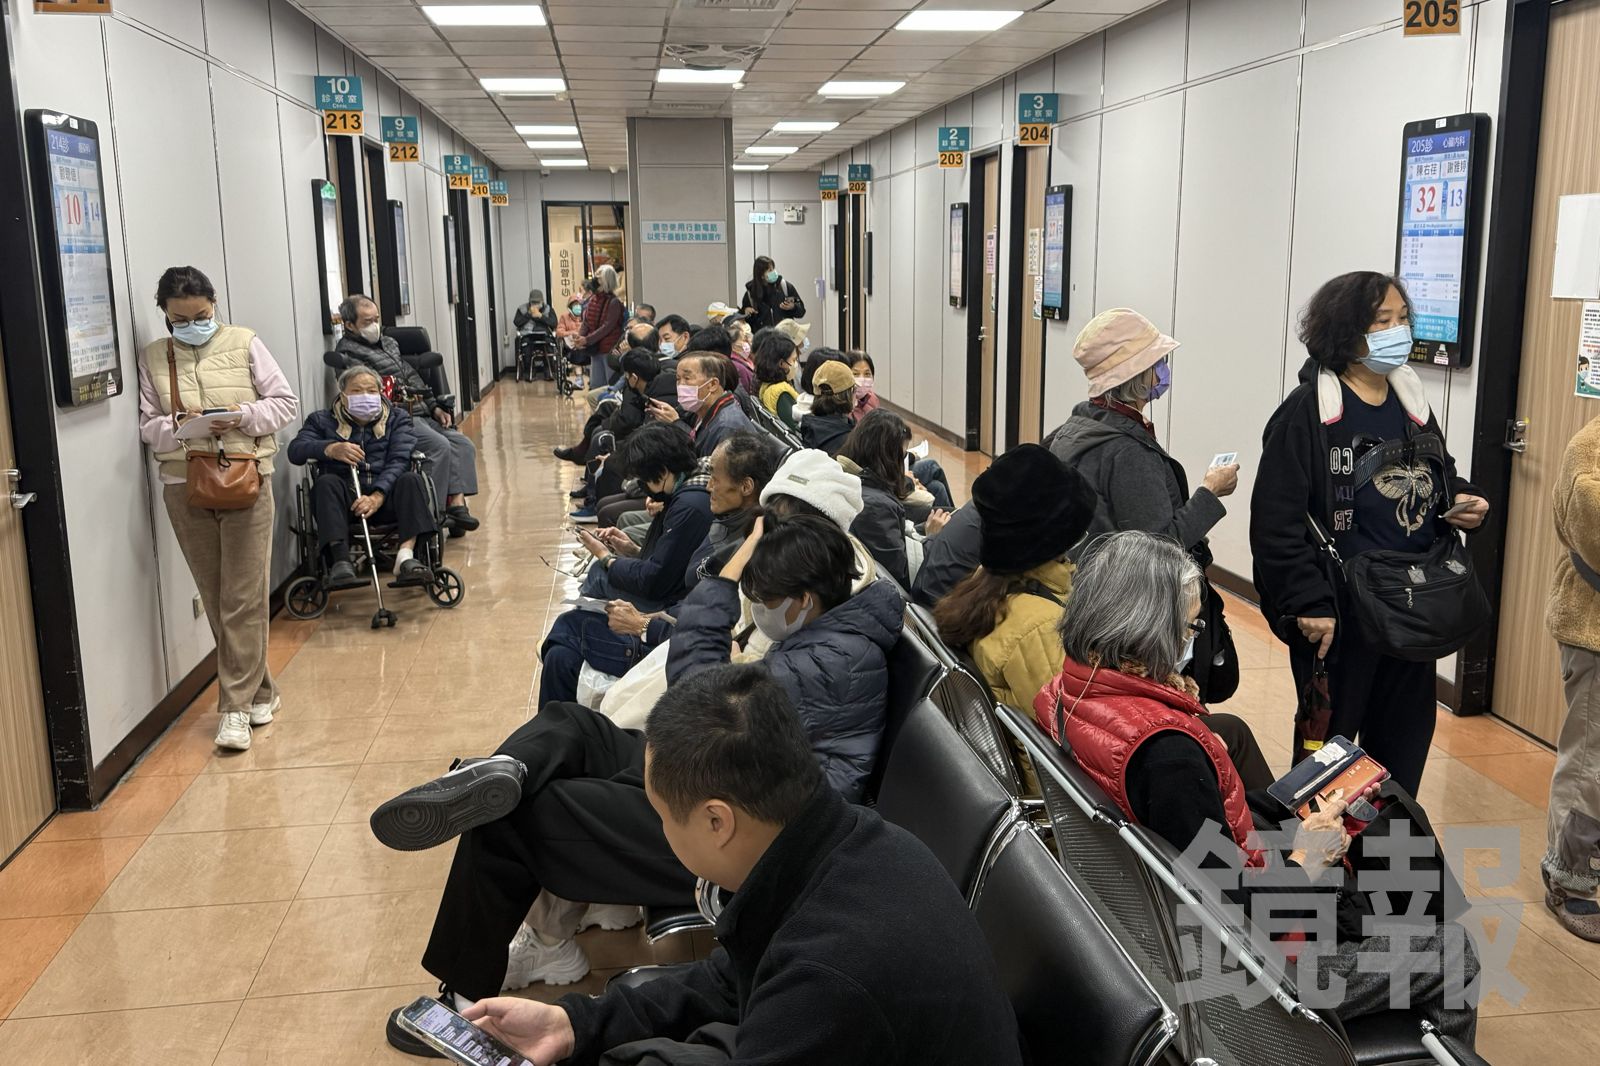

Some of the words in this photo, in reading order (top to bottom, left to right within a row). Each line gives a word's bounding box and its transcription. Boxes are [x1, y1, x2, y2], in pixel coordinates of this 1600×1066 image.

[1406, 0, 1459, 28] 205
[327, 78, 350, 94] 10
[321, 94, 357, 103] 診察室
[1033, 95, 1044, 109] 3
[1024, 109, 1053, 118] 診察室
[326, 113, 362, 130] 213
[394, 118, 405, 131] 9
[949, 128, 958, 140] 2
[1020, 126, 1049, 141] 204
[1411, 138, 1434, 153] 205診
[390, 146, 418, 159] 212
[453, 156, 461, 165] 8
[940, 153, 963, 165] 203
[857, 165, 862, 173] 1
[450, 176, 469, 186] 211
[849, 183, 866, 191] 202
[471, 185, 488, 195] 210
[492, 196, 507, 204] 209
[1416, 186, 1436, 213] 32
[1450, 188, 1463, 207] 13
[65, 193, 81, 225] 10
[90, 201, 100, 222] 14
